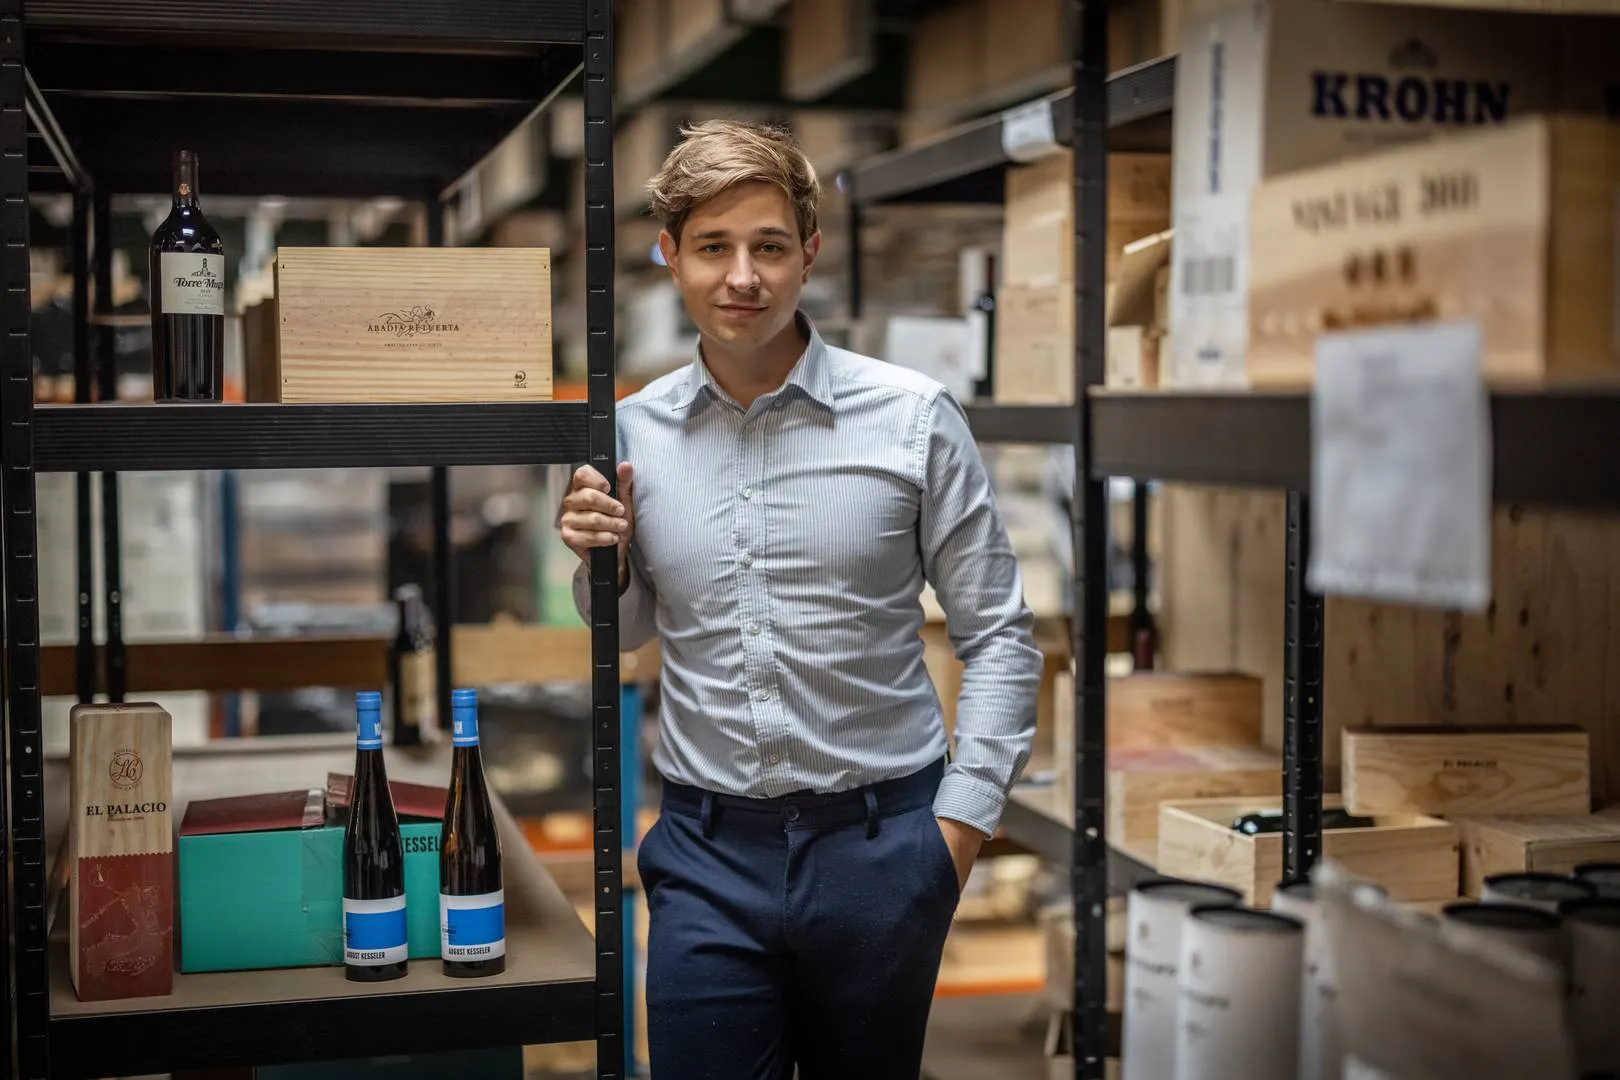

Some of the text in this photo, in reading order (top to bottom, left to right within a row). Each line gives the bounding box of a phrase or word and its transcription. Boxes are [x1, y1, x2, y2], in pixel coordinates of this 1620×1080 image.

[1310, 69, 1510, 124] KROHN
[173, 277, 202, 288] Torre
[86, 802, 166, 816] EL PALACIO
[466, 946, 490, 955] KESSELER
